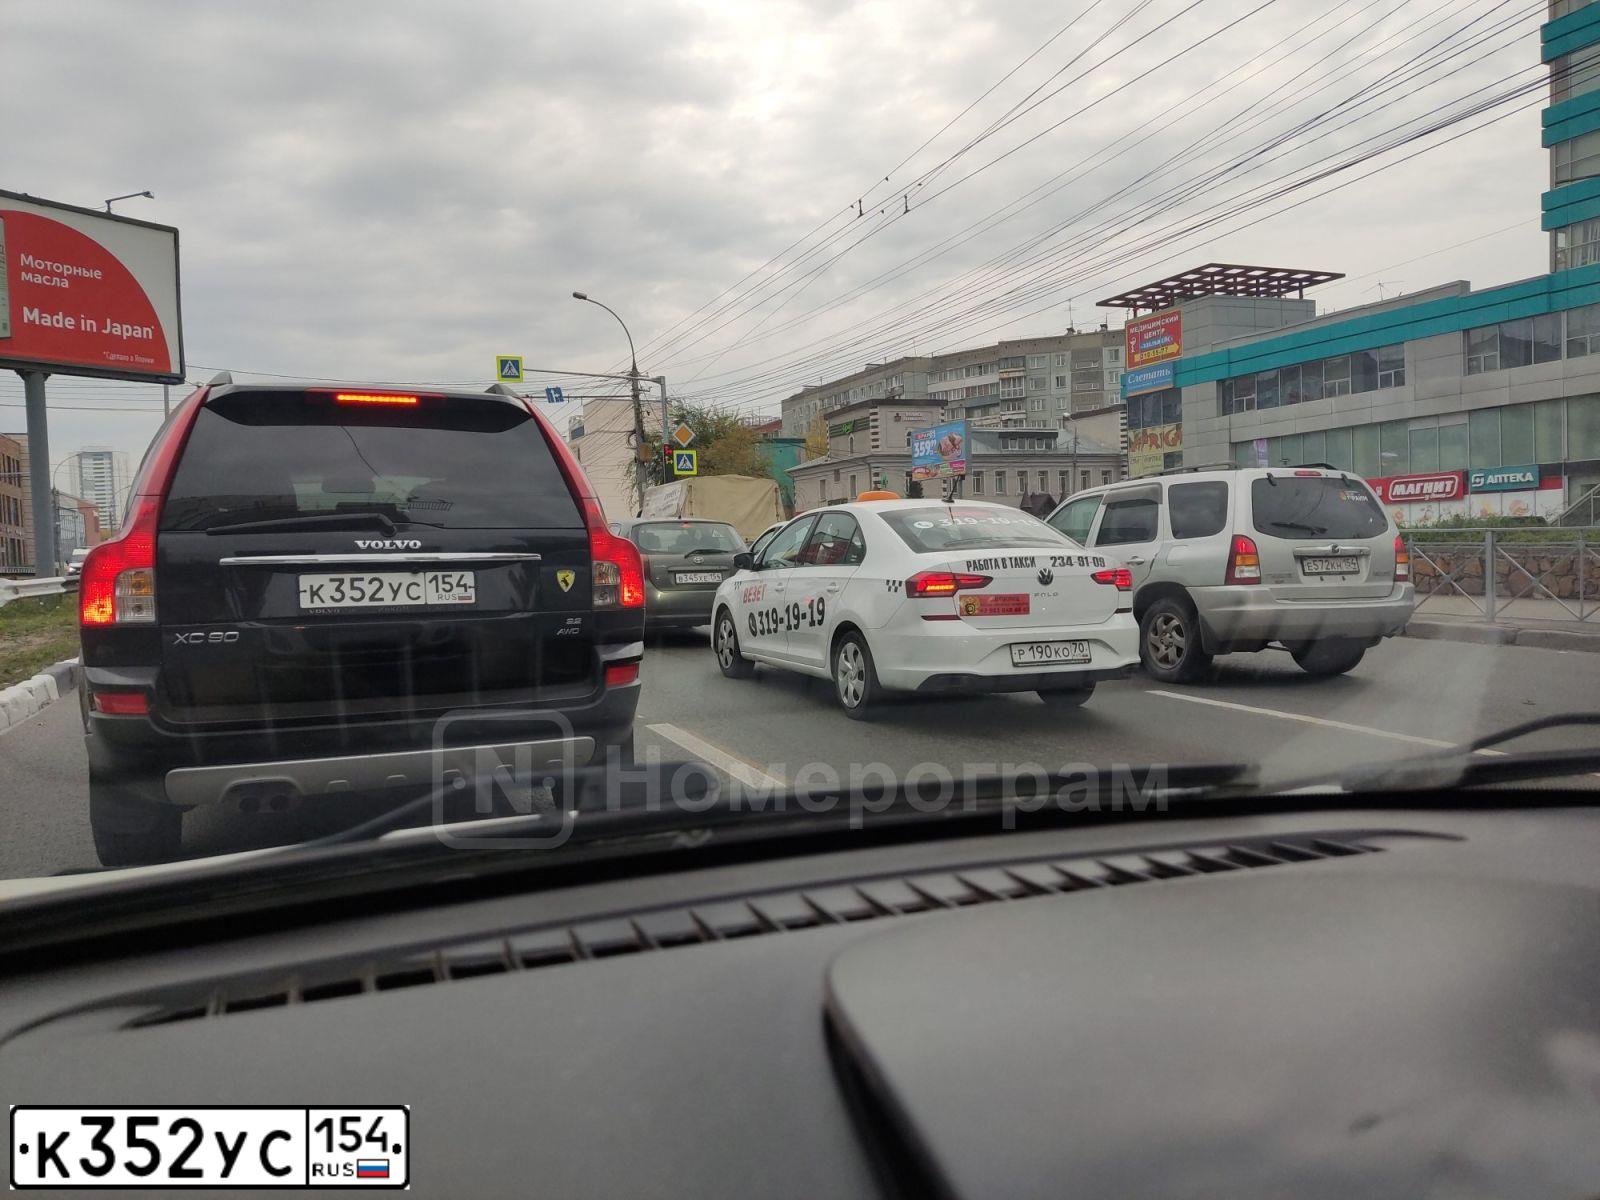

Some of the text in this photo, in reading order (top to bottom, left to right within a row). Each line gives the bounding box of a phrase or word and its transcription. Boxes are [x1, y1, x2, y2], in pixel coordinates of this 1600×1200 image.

[20, 253, 103, 280] Моторные
[21, 271, 69, 288] масла
[23, 306, 75, 330] Made
[81, 314, 97, 332] in
[1130, 315, 1179, 334] МЕДИЦИНСКИЙ
[1143, 328, 1166, 339] ЦЕНТР
[1487, 472, 1534, 484] АПТЕКА
[1392, 481, 1454, 495] МАГНИТ
[354, 540, 422, 549] VOLVO
[966, 558, 1000, 572] РАБОТА
[1002, 557, 1008, 569] В
[1009, 556, 1037, 569] ТАКСИ
[1306, 560, 1343, 571] Е572КН
[309, 574, 469, 604] К352УС 154
[757, 596, 825, 636] 319-19-19
[556, 627, 580, 636] AWD
[1018, 642, 1085, 660] Р190КО 70
